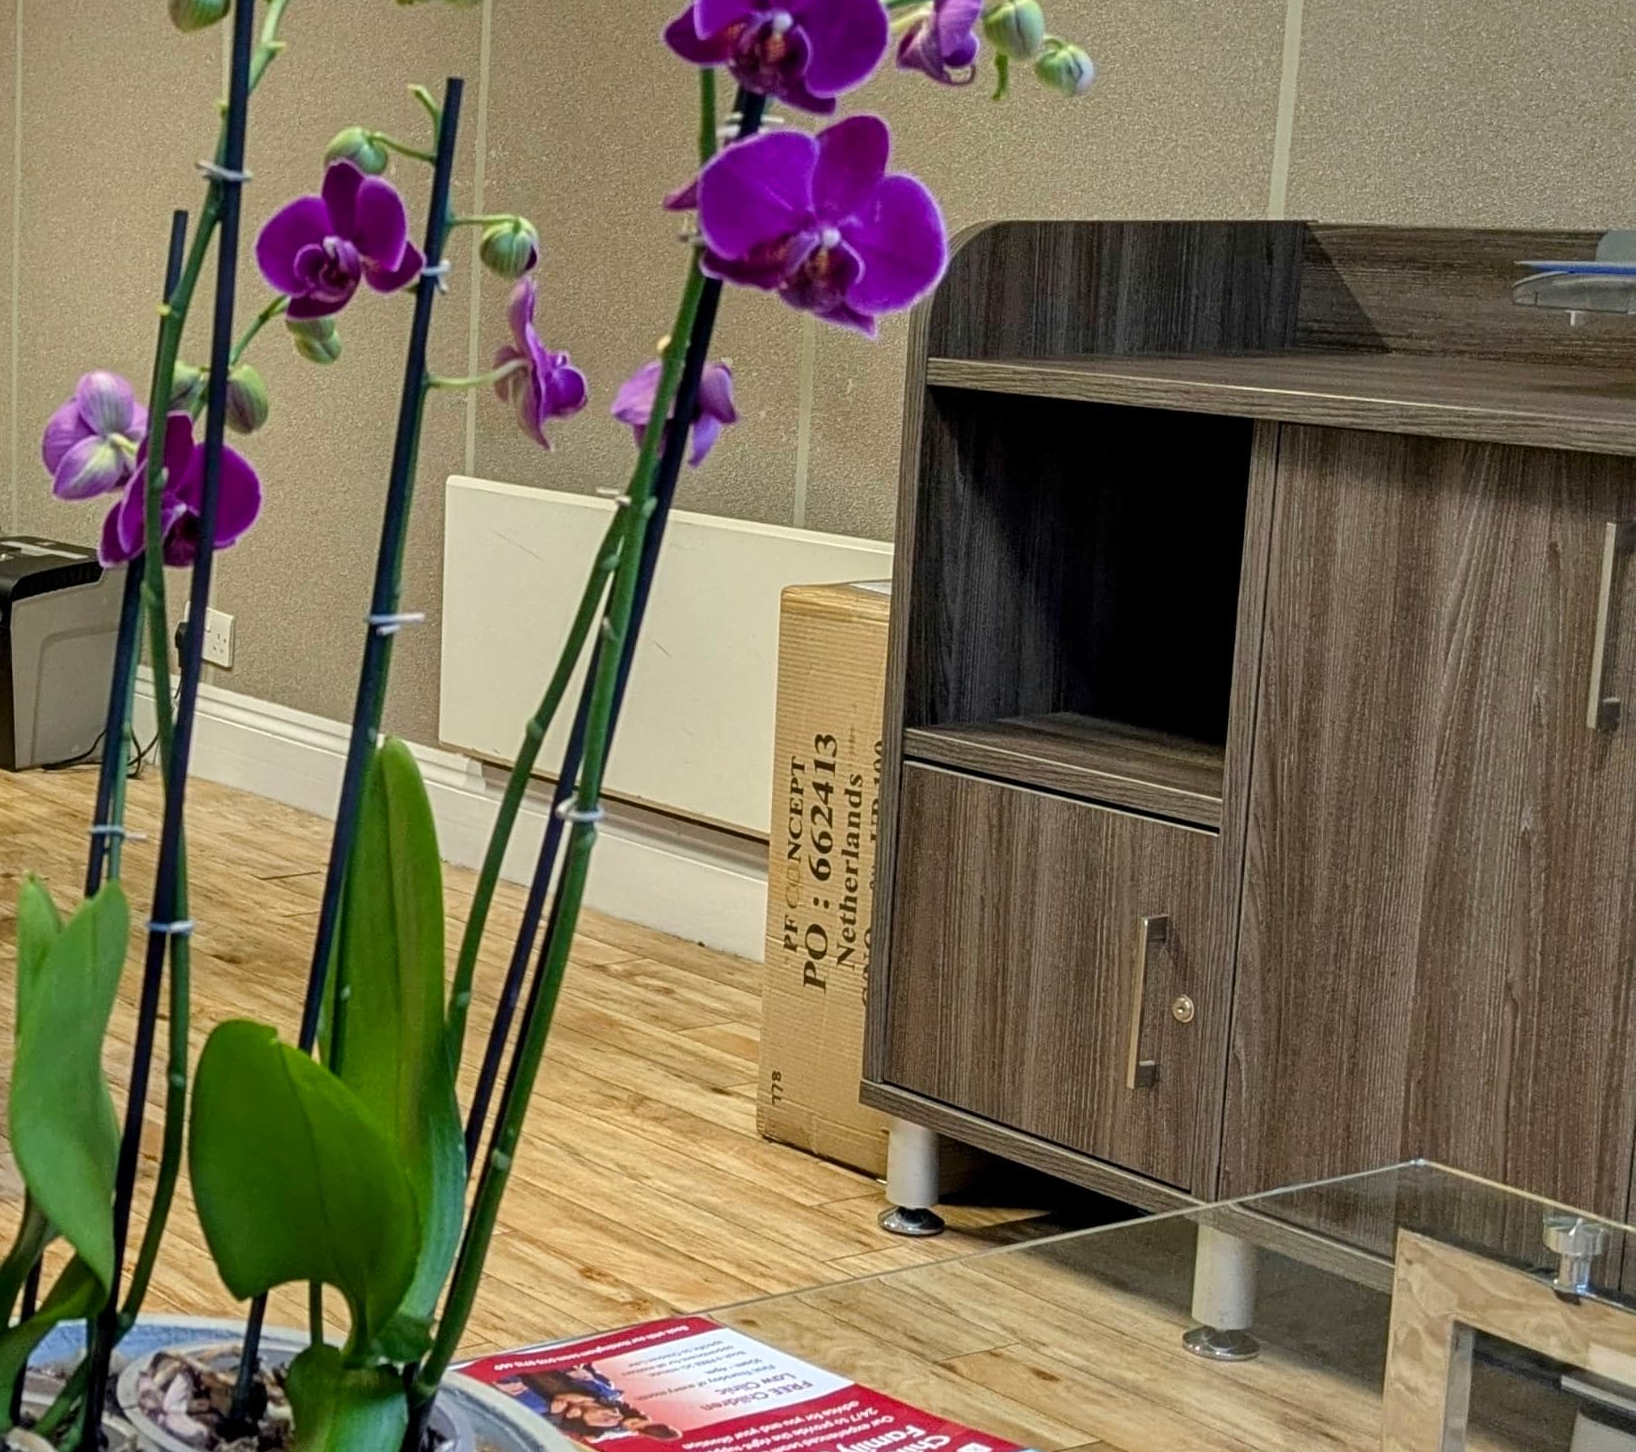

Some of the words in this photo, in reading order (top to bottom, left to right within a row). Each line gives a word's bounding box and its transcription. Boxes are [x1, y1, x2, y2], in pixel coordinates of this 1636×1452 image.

[809, 734, 838, 882] 662413
[836, 774, 864, 972] Netherlands
[784, 915, 799, 953] PF
[803, 923, 828, 995] PO
[715, 1382, 760, 1395] Clinic
[761, 1373, 796, 1384] Law
[768, 1380, 813, 1395] FREE
[699, 1392, 769, 1411] Children
